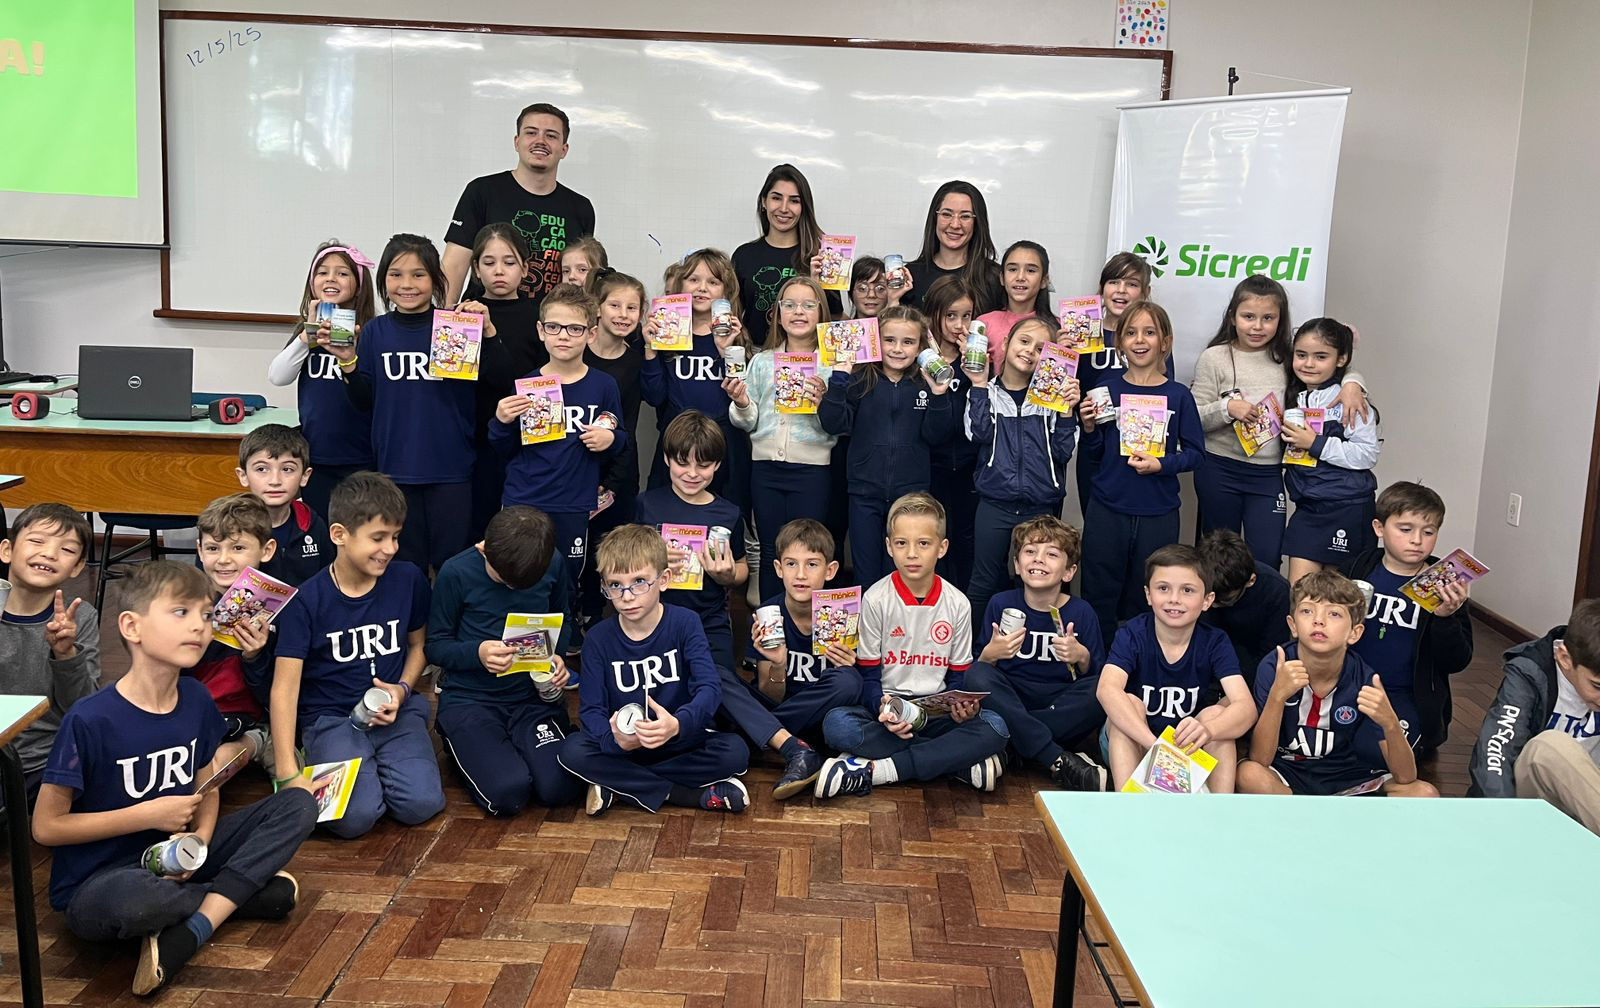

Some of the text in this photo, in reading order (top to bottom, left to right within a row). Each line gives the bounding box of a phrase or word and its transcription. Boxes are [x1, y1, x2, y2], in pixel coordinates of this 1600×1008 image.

[0, 38, 46, 77] A!
[540, 214, 566, 227] EDU
[541, 237, 567, 251] ÇÃO
[782, 267, 798, 279] ED
[1175, 244, 1313, 281] Sicredi
[307, 353, 343, 381] UR
[381, 351, 443, 381] UR
[673, 355, 724, 381] UR
[1091, 347, 1129, 370] UR
[915, 398, 929, 407] UR
[563, 404, 599, 434] RI
[302, 544, 319, 554] URI
[1332, 537, 1349, 547] URI
[326, 619, 401, 663] URI
[1016, 631, 1079, 662] UR
[611, 649, 680, 693] URI
[900, 650, 951, 667] Banrisu
[1142, 684, 1200, 718] URI
[536, 730, 555, 740] URI
[116, 738, 197, 799] URI
